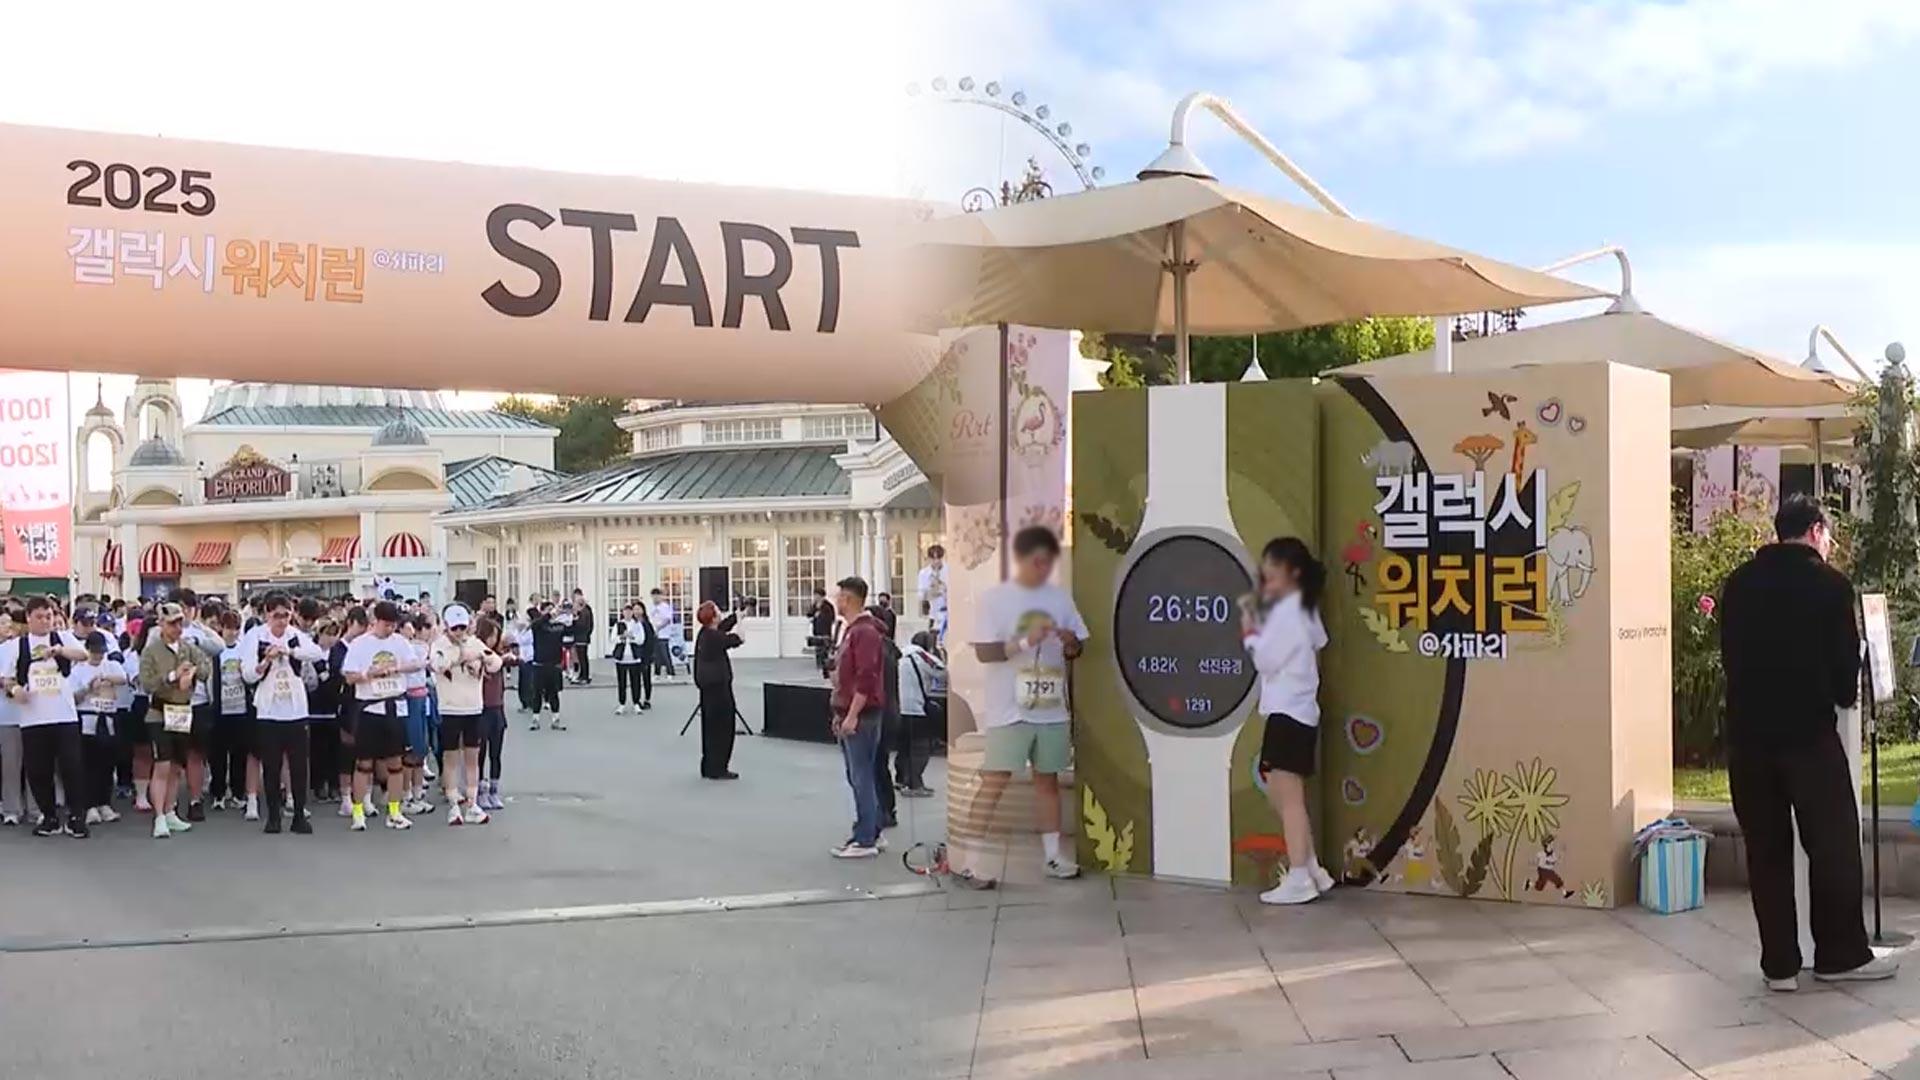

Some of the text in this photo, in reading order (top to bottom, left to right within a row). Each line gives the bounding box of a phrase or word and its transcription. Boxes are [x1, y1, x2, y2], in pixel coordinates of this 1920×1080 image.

[66, 159, 216, 217] 2025
[65, 226, 216, 293] 갤럭시
[222, 238, 366, 303] 워치런
[480, 203, 862, 333] START
[214, 475, 283, 497] EMPORIUM
[233, 467, 265, 479] GRAND
[1374, 469, 1547, 549] 갤럭시
[1374, 554, 1547, 634] 워치런
[1148, 595, 1229, 623] 26:50
[1418, 633, 1508, 660] @사파리
[1138, 656, 1179, 674] 4.82K
[1025, 681, 1055, 695] 1291
[1185, 698, 1212, 712] 1291
